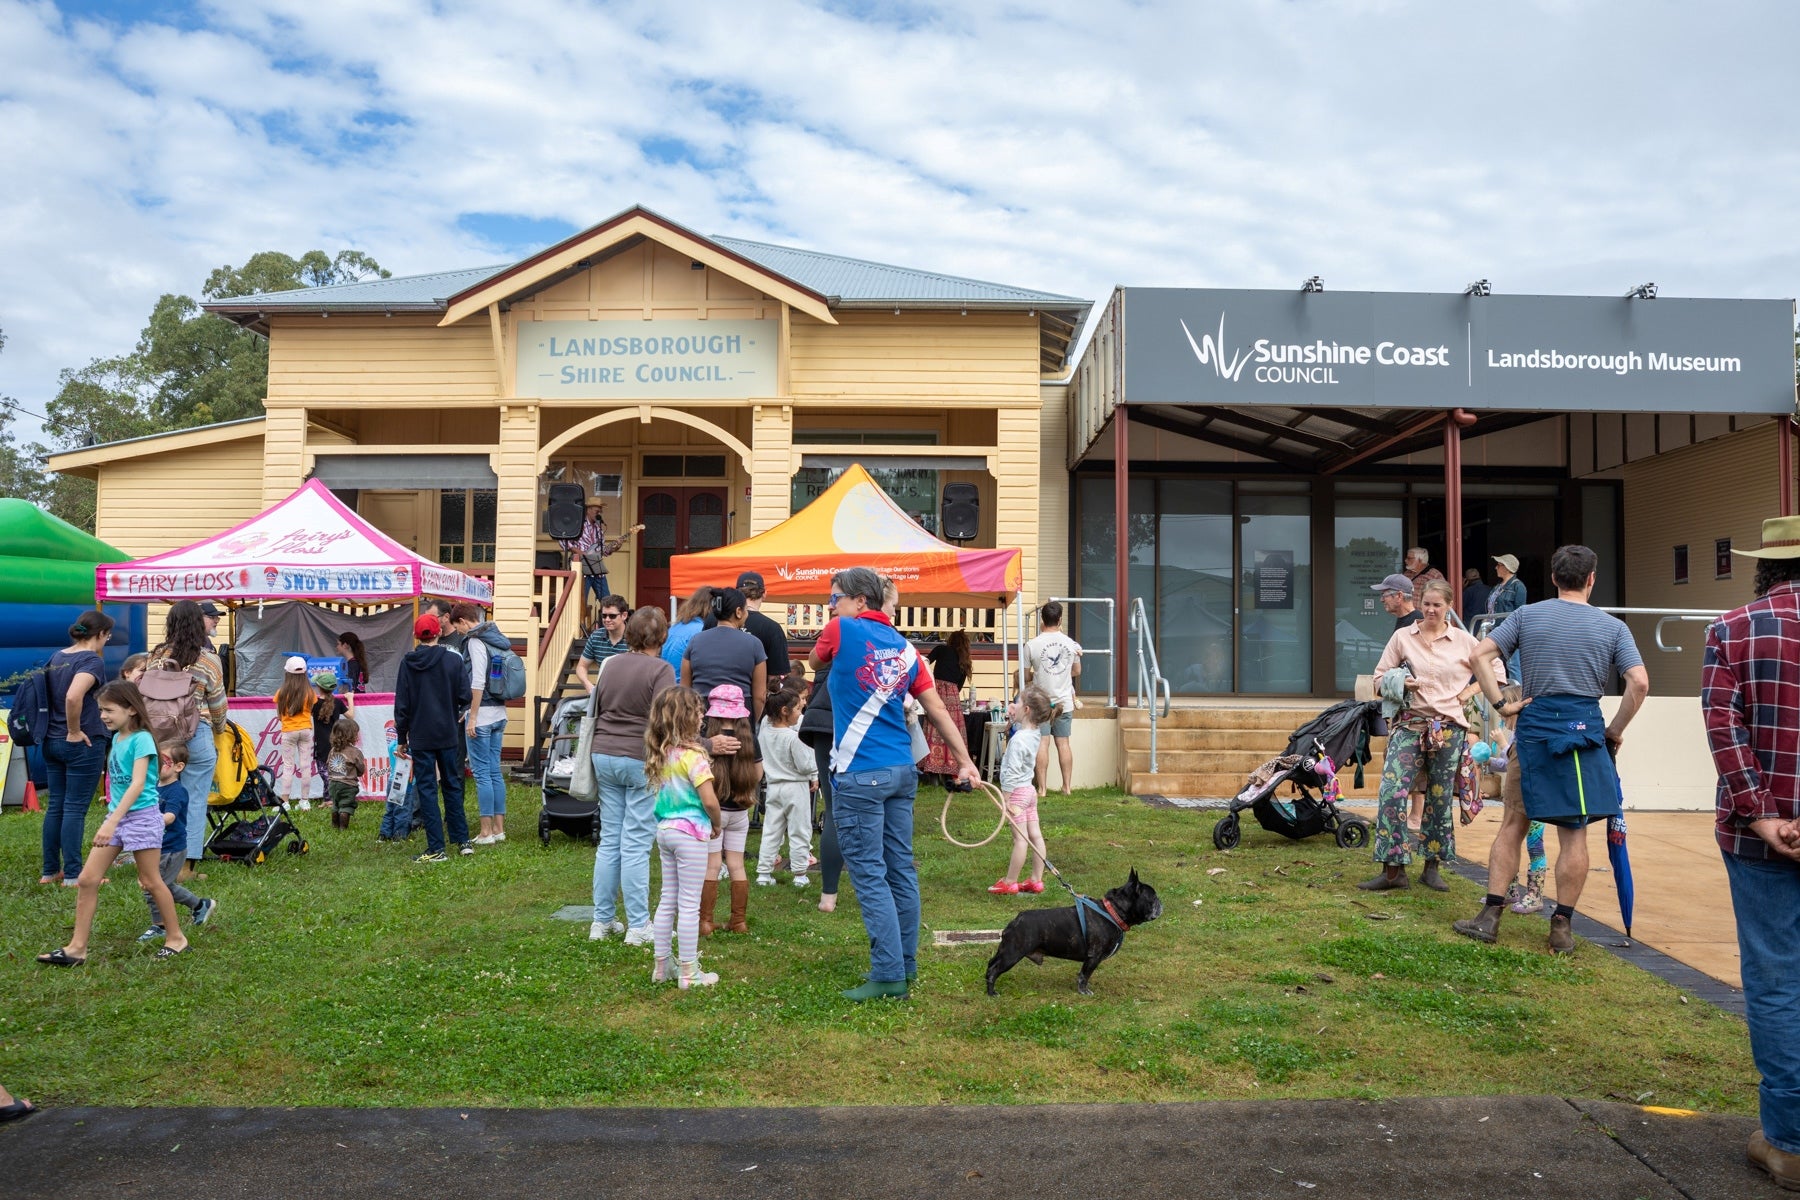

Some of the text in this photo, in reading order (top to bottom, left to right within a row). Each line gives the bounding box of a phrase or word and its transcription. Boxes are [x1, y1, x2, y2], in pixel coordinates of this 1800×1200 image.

[550, 335, 741, 357] LANDSBOROUGH
[1254, 339, 1450, 366] Sunshine Coast
[1488, 349, 1741, 375] Landsborough Museum
[560, 364, 733, 384] SHIRE COUNCIL.
[1255, 366, 1339, 384] COUNCIL
[253, 541, 328, 558] floss
[128, 570, 235, 593] FAIRY FLOSS
[283, 571, 392, 591] SNOW CONES
[796, 568, 829, 576] Sunshine
